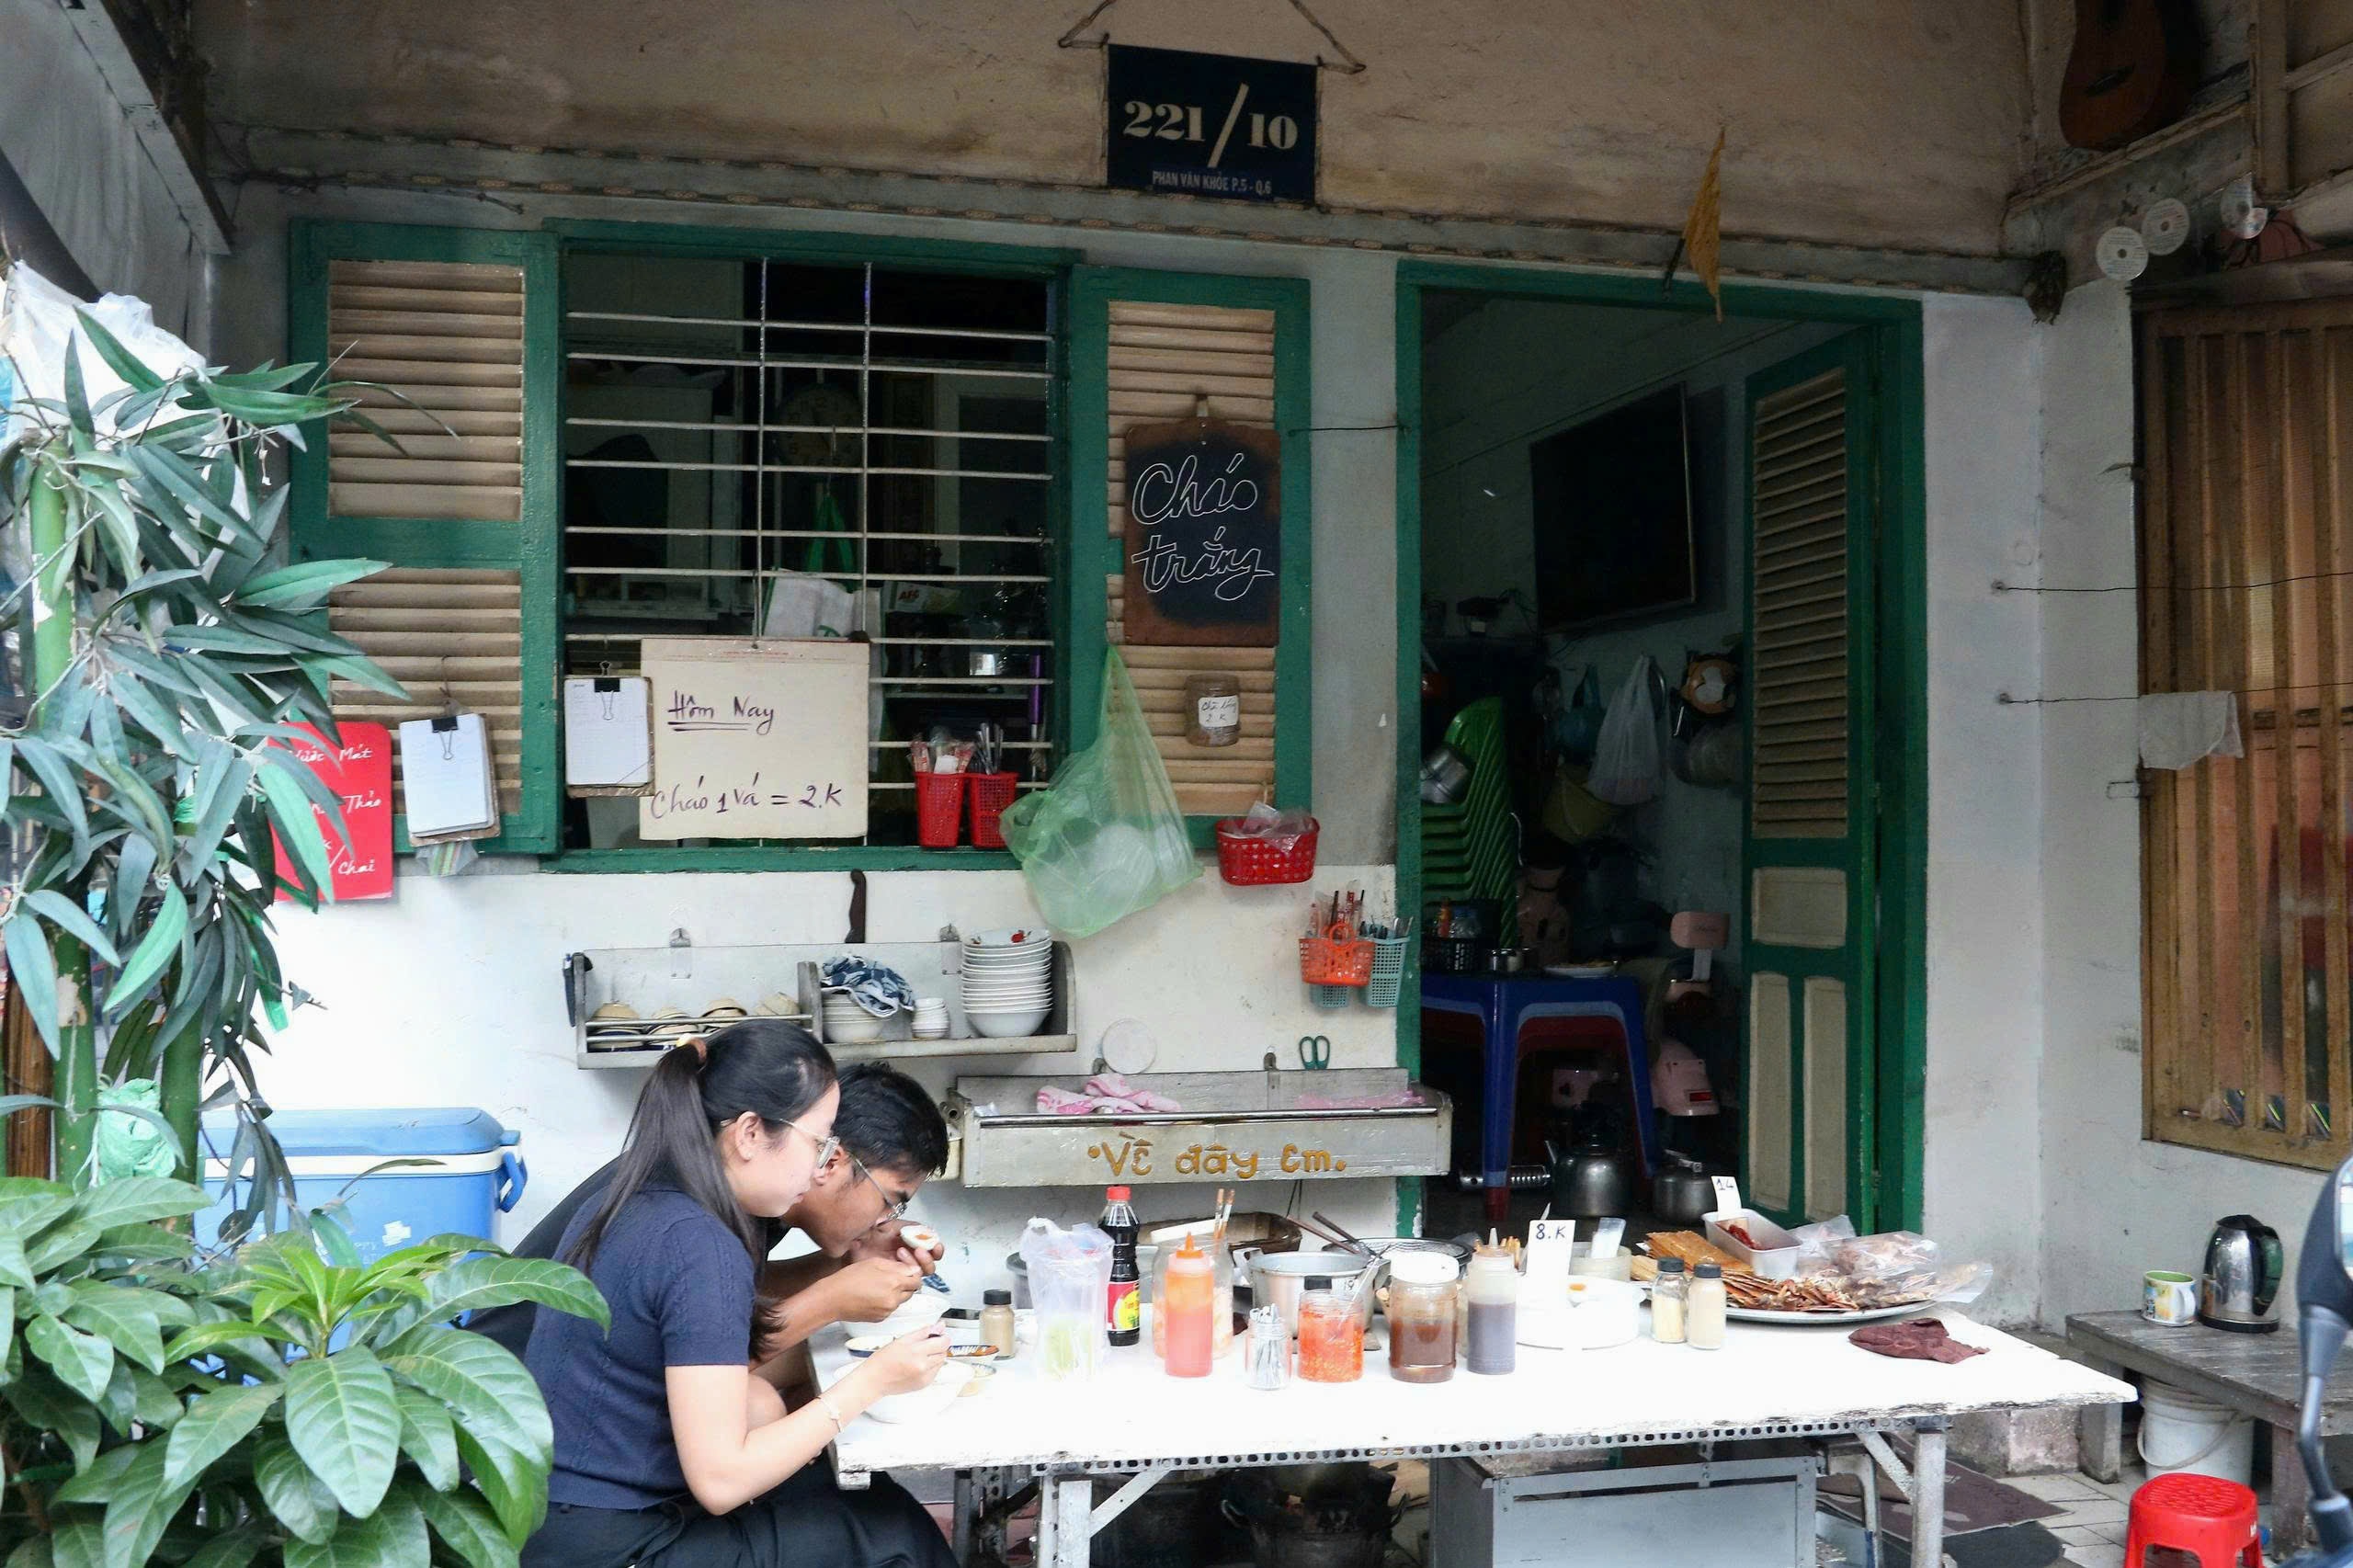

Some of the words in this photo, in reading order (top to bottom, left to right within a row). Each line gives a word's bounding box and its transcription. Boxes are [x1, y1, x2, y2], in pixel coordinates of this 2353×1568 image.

[1123, 82, 1299, 169] 221/10
[1152, 170, 1178, 186] PHAN
[1255, 179, 1272, 196] Q.6
[1131, 452, 1258, 525] Cháo
[1131, 526, 1276, 601] trắng
[667, 689, 715, 720] Hôm
[733, 695, 776, 735] Nay
[338, 744, 373, 762] Mát
[650, 774, 709, 819] Cháo
[1102, 1131, 1154, 1176] Về
[1175, 1142, 1258, 1178] đây
